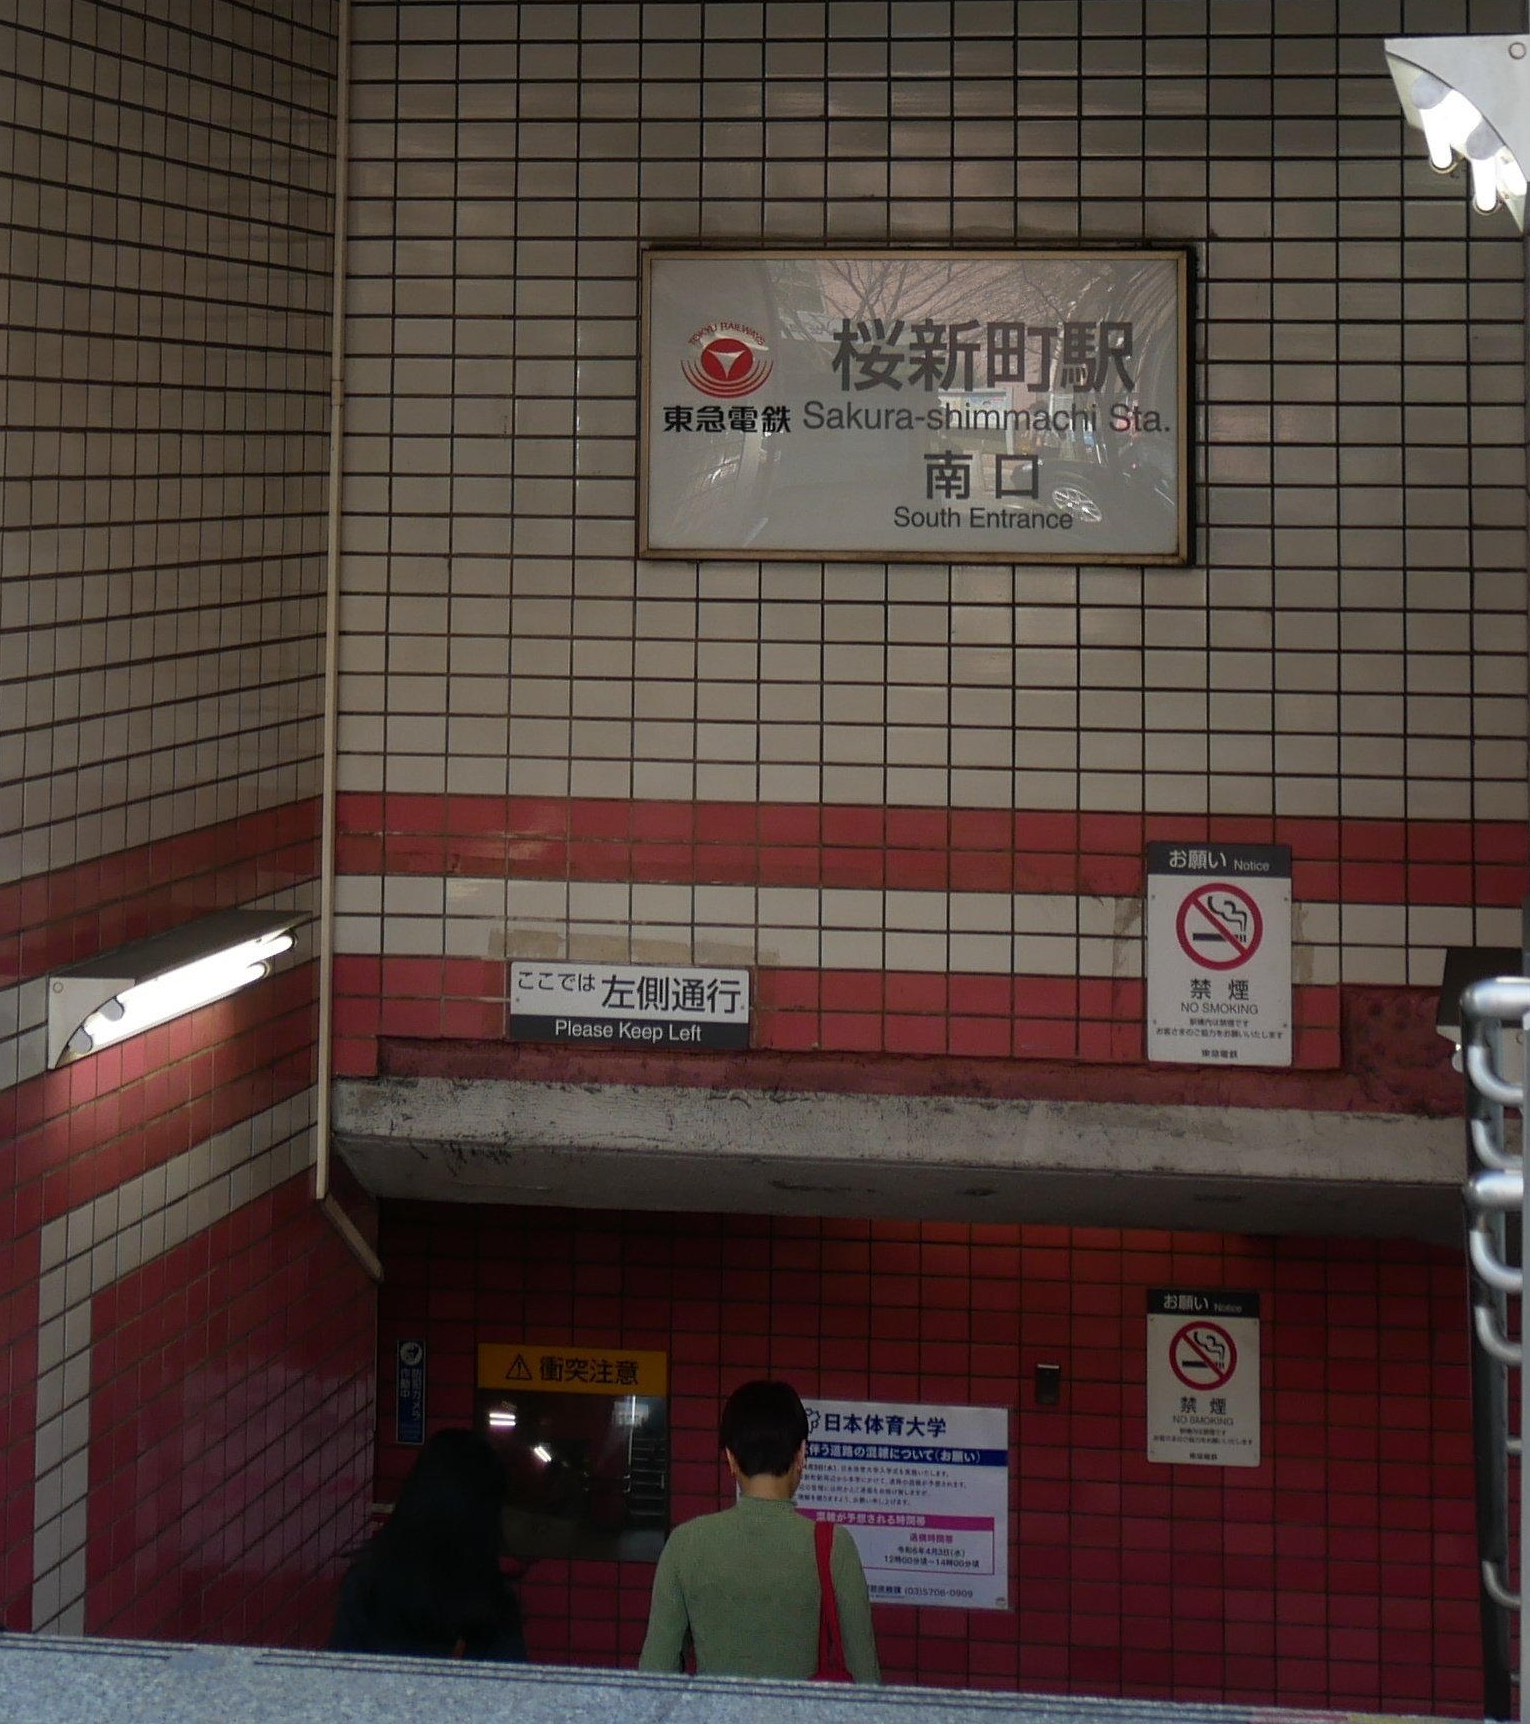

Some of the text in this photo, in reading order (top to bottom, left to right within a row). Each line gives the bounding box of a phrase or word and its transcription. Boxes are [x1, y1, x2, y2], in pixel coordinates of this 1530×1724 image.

[688, 321, 766, 346] TOKYU RAILWAYS
[831, 317, 1136, 394] 桜新町駅
[662, 405, 792, 434] 東急電鉄
[802, 401, 1171, 433] Sakura-shimmachi Sta.
[923, 450, 1039, 501] 南口
[893, 506, 1074, 531] South Entrance
[1169, 849, 1270, 872] お願い Notice
[518, 971, 742, 1014] ここでは 左側通行
[1190, 978, 1249, 1001] 禁煙
[1181, 1001, 1259, 1015] NO SMOKING
[555, 1019, 702, 1044] Please Keep Left
[1163, 1293, 1209, 1311] お願い
[539, 1355, 639, 1386] 衝突注意
[824, 1412, 947, 1439] 日本体育大学
